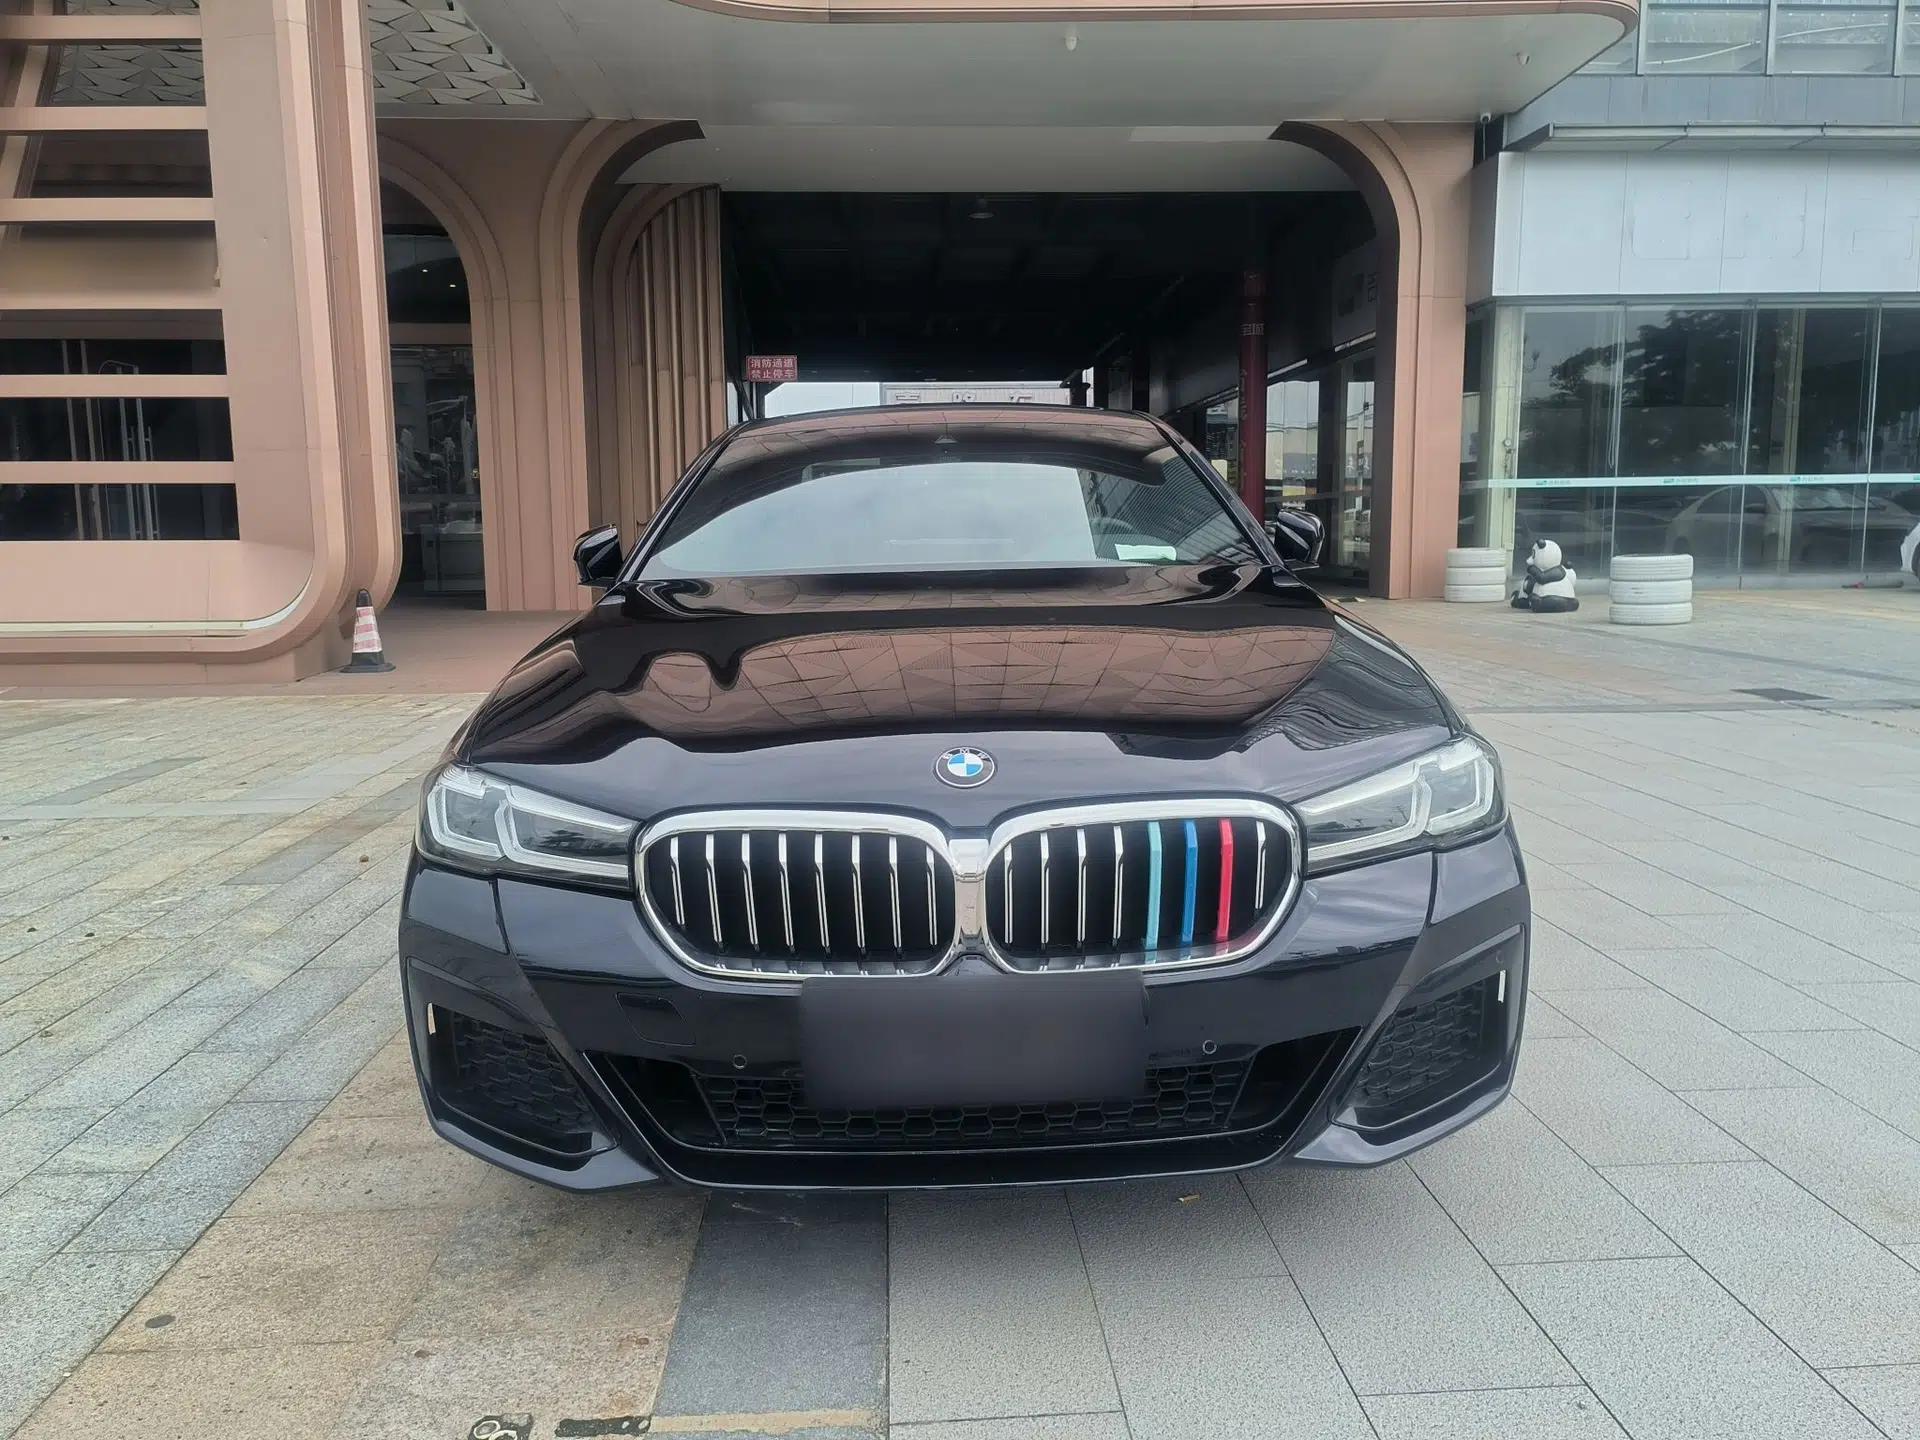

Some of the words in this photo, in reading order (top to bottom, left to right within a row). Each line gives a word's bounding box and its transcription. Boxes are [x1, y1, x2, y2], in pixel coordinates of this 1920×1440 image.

[751, 358, 794, 369] 消防通道
[751, 368, 794, 379] 禁止停车
